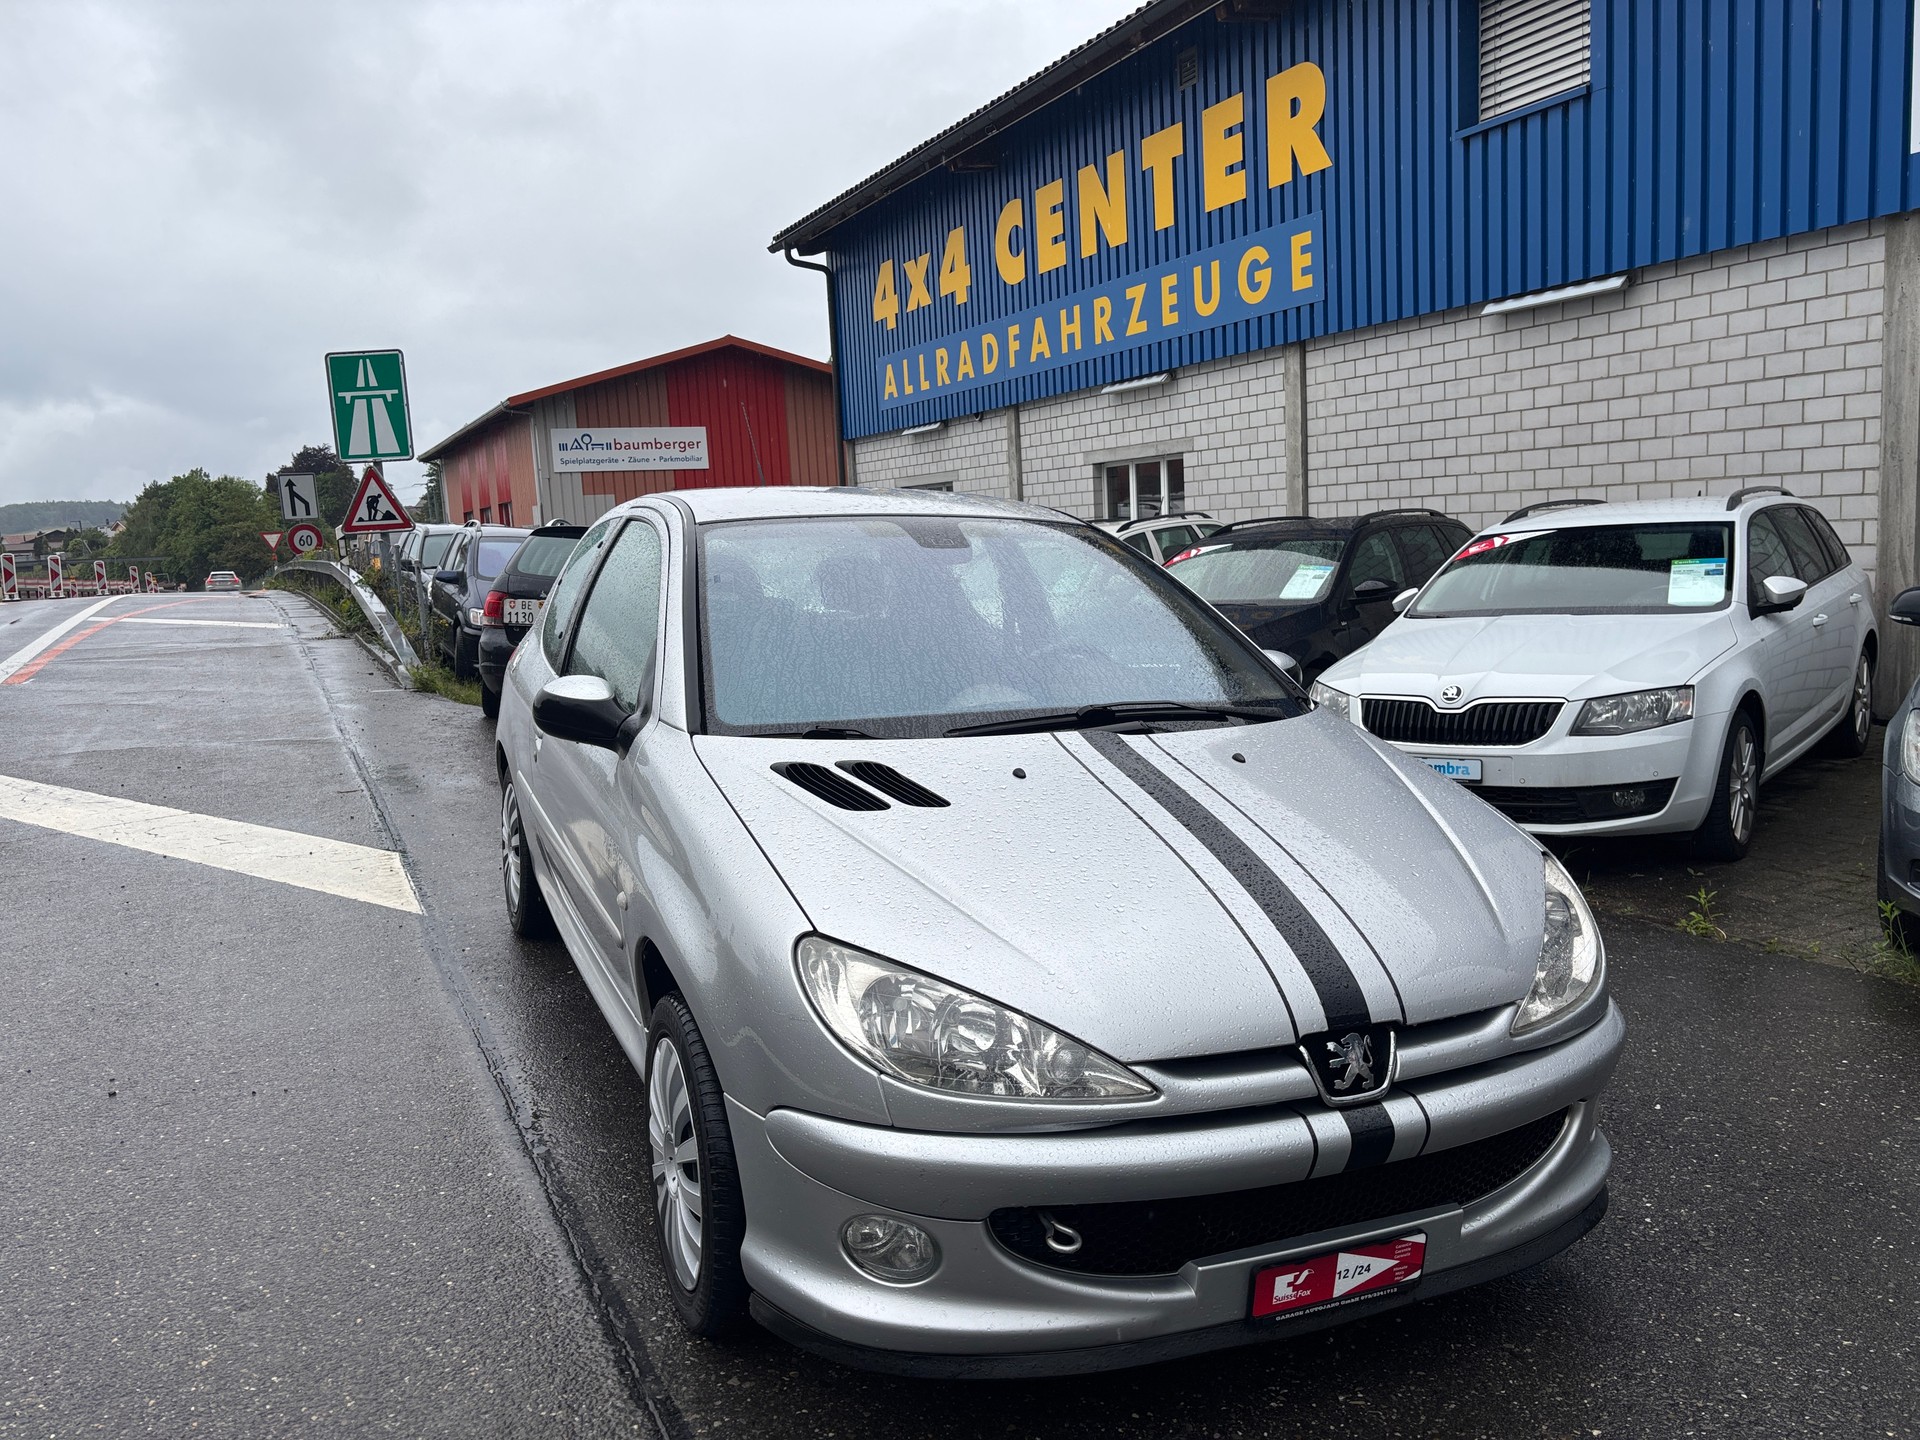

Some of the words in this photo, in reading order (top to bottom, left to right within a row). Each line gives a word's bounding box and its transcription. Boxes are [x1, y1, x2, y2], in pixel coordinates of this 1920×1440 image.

[873, 225, 972, 331] 4x4
[994, 61, 1333, 286] CENTER
[883, 230, 1314, 401] ALLRADFAHRZEUGE
[613, 437, 702, 453] baumberger
[560, 457, 619, 466] Spielplatzgeräte
[627, 456, 650, 464] Zäune
[658, 455, 703, 463] Parkmobiliar
[298, 534, 313, 547] 60
[521, 600, 533, 610] BE
[1336, 1270, 1349, 1280] 12
[1275, 1310, 1304, 1321] GARAGE
